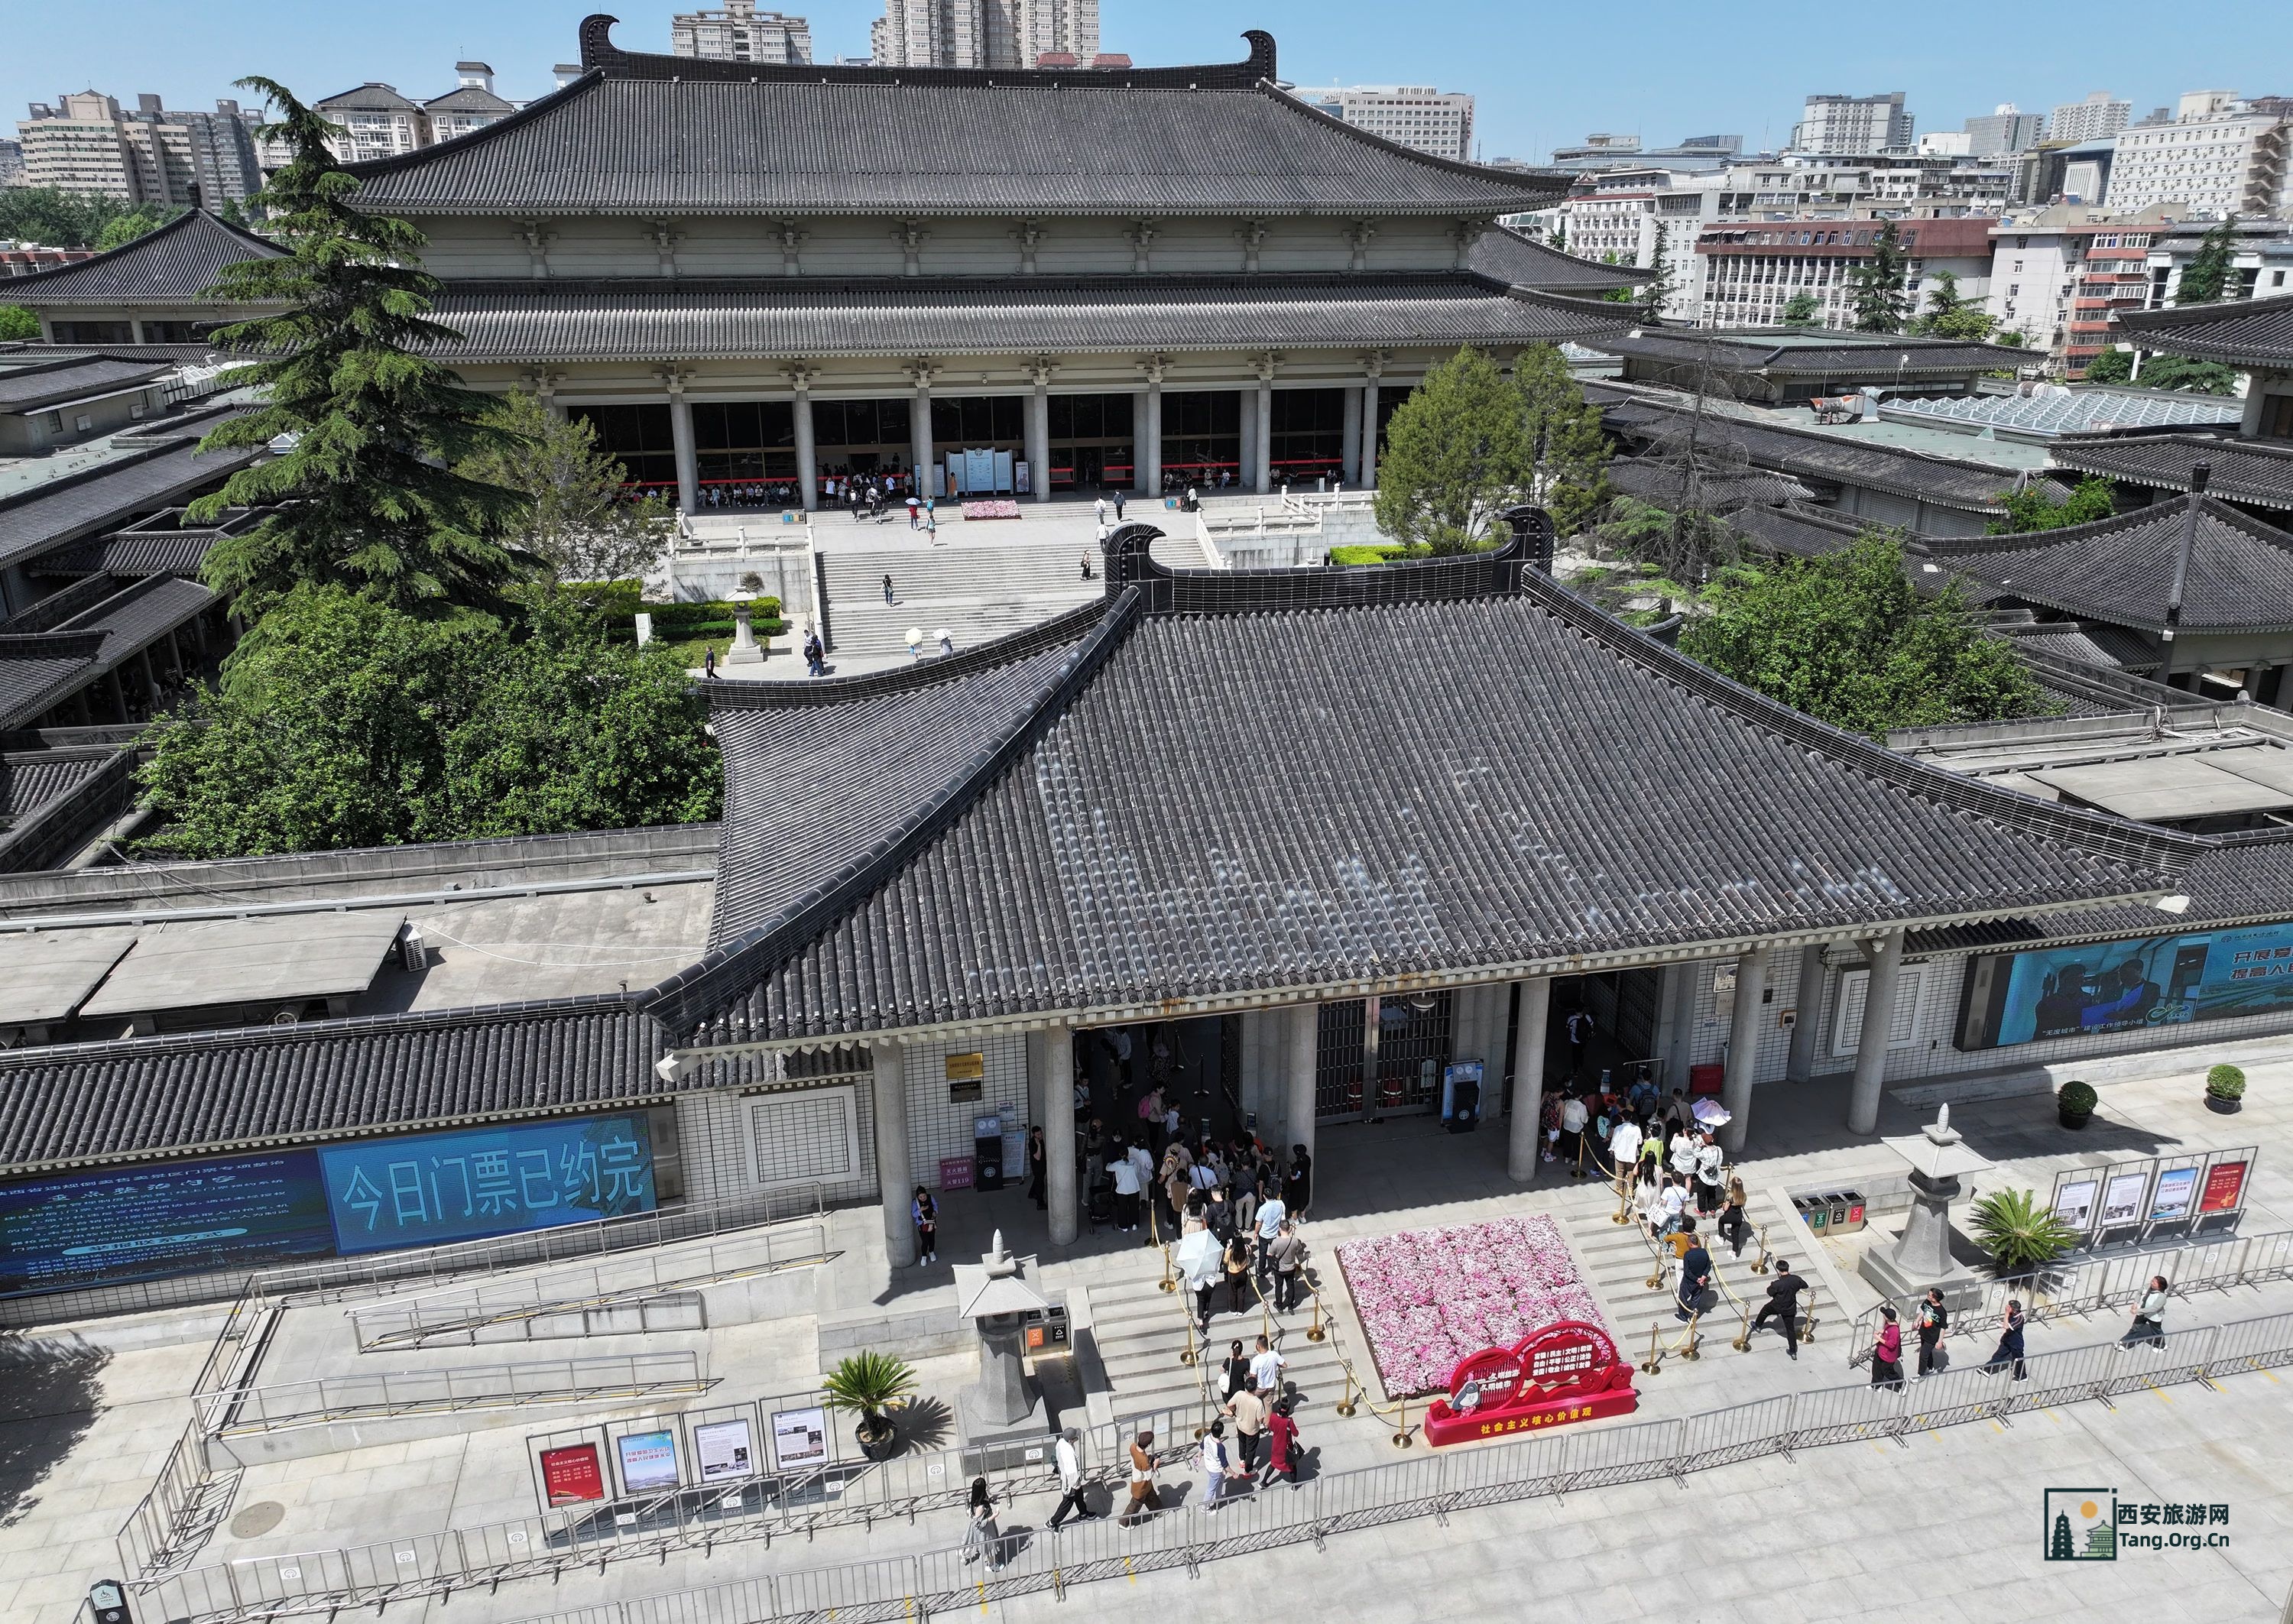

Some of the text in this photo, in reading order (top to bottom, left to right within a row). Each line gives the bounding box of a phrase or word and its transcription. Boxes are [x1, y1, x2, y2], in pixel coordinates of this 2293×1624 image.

[2233, 946, 2293, 964] 开展爱
[342, 1136, 644, 1231] 今日门票已约完
[1481, 1407, 1592, 1434] 社会主义核心价值观
